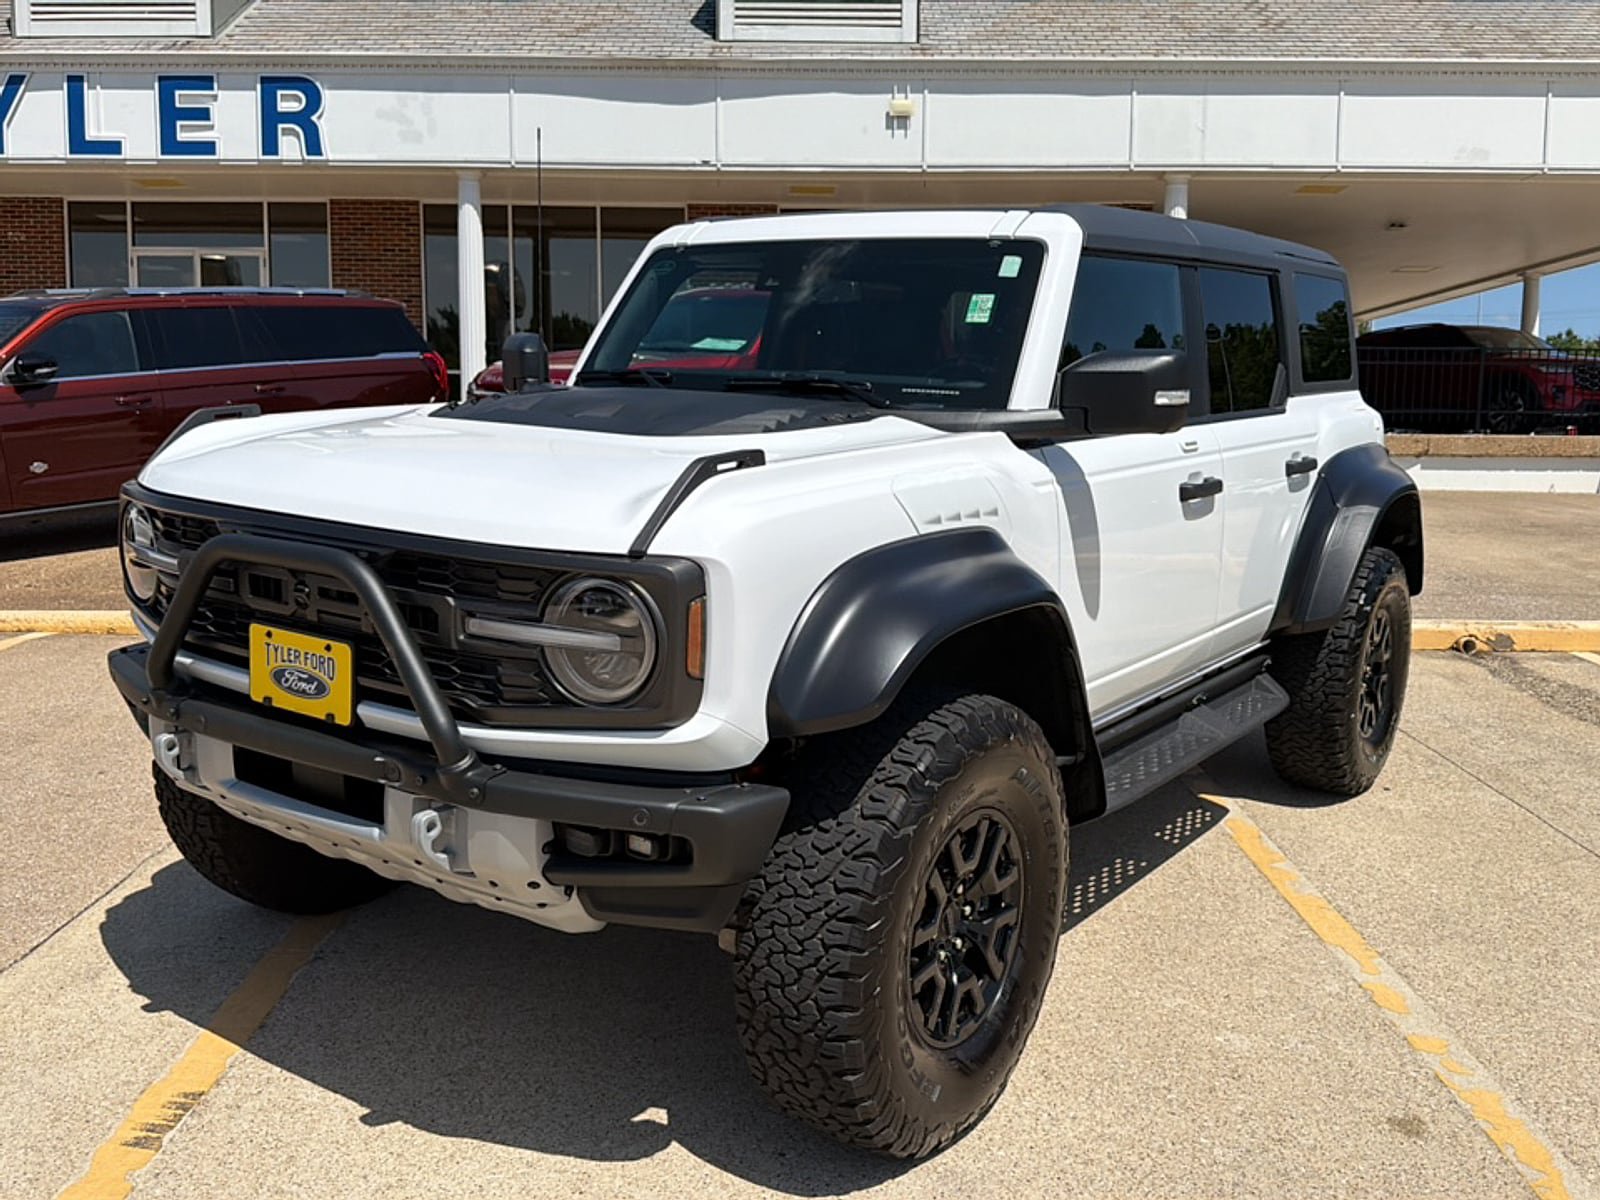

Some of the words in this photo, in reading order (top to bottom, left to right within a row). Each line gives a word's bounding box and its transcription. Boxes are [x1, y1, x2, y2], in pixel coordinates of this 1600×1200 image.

[264, 641, 302, 667] TYLER
[303, 652, 336, 682] FORD
[281, 668, 318, 695] Ford
